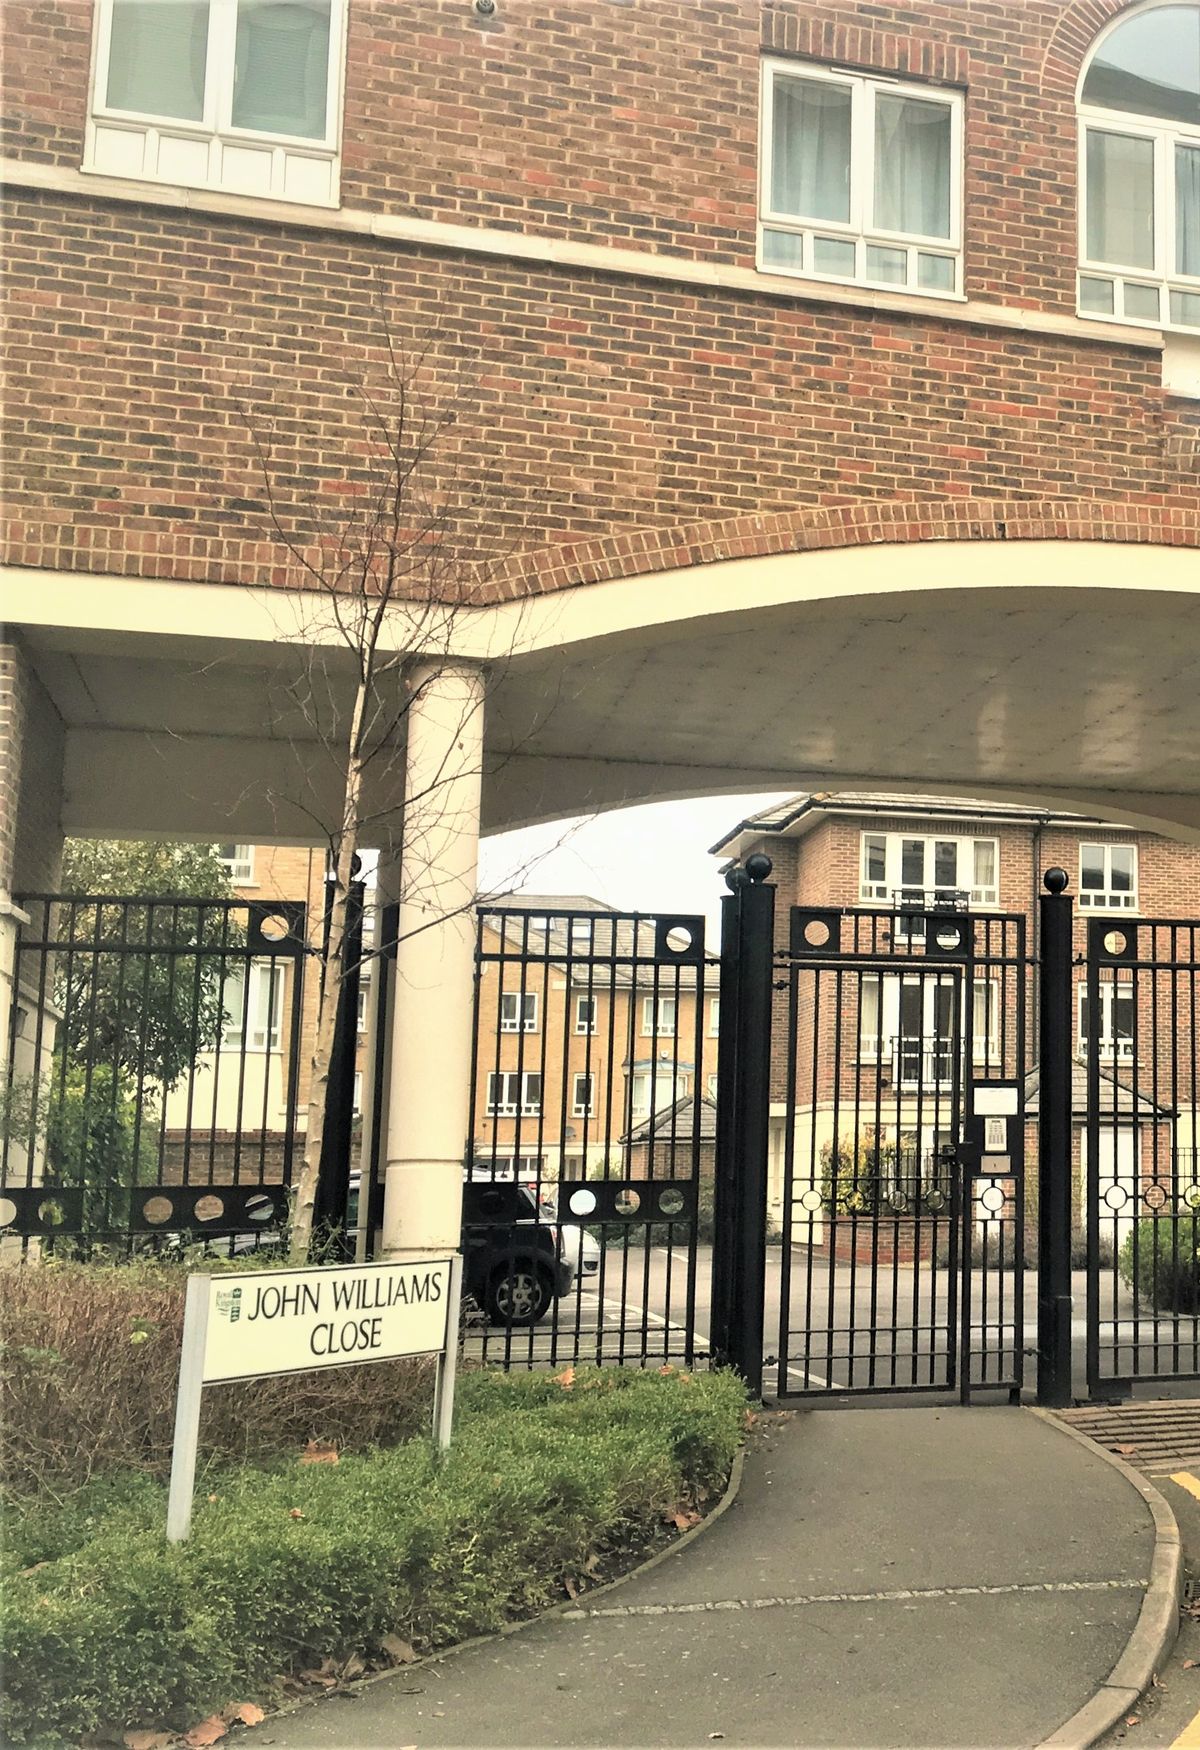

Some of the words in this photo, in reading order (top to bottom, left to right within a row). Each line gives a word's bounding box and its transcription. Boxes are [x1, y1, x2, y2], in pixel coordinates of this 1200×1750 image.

[248, 1282, 321, 1321] JOHN
[332, 1272, 442, 1312] WILLIAMS
[310, 1317, 383, 1356] CLOSE
